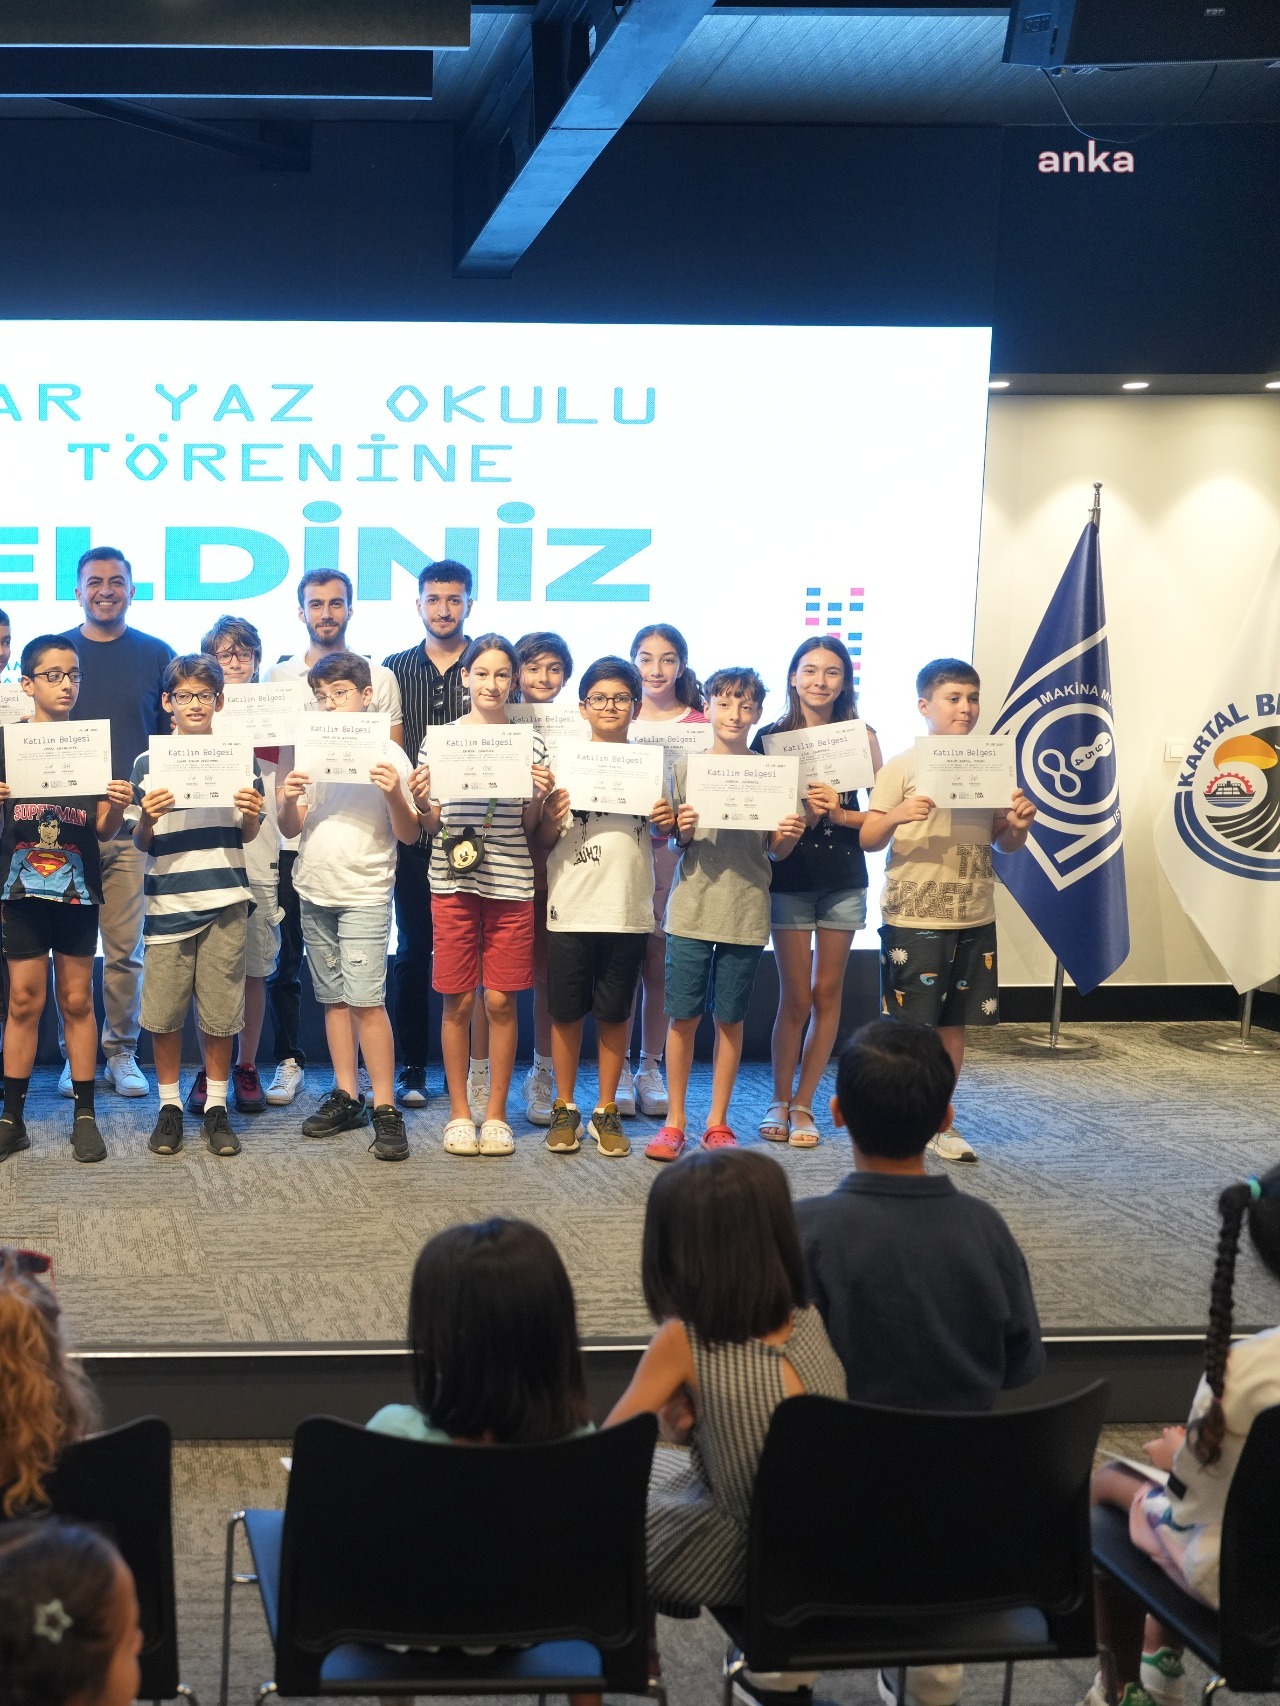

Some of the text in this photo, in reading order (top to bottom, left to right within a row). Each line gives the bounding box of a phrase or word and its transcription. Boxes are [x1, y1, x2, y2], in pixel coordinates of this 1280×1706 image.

[155, 383, 314, 422] YAZ
[386, 384, 656, 425] OKULU
[68, 433, 513, 482] TÖRENİNE
[1040, 681, 1099, 705] MAKİNA
[1177, 703, 1250, 787] KARTAL
